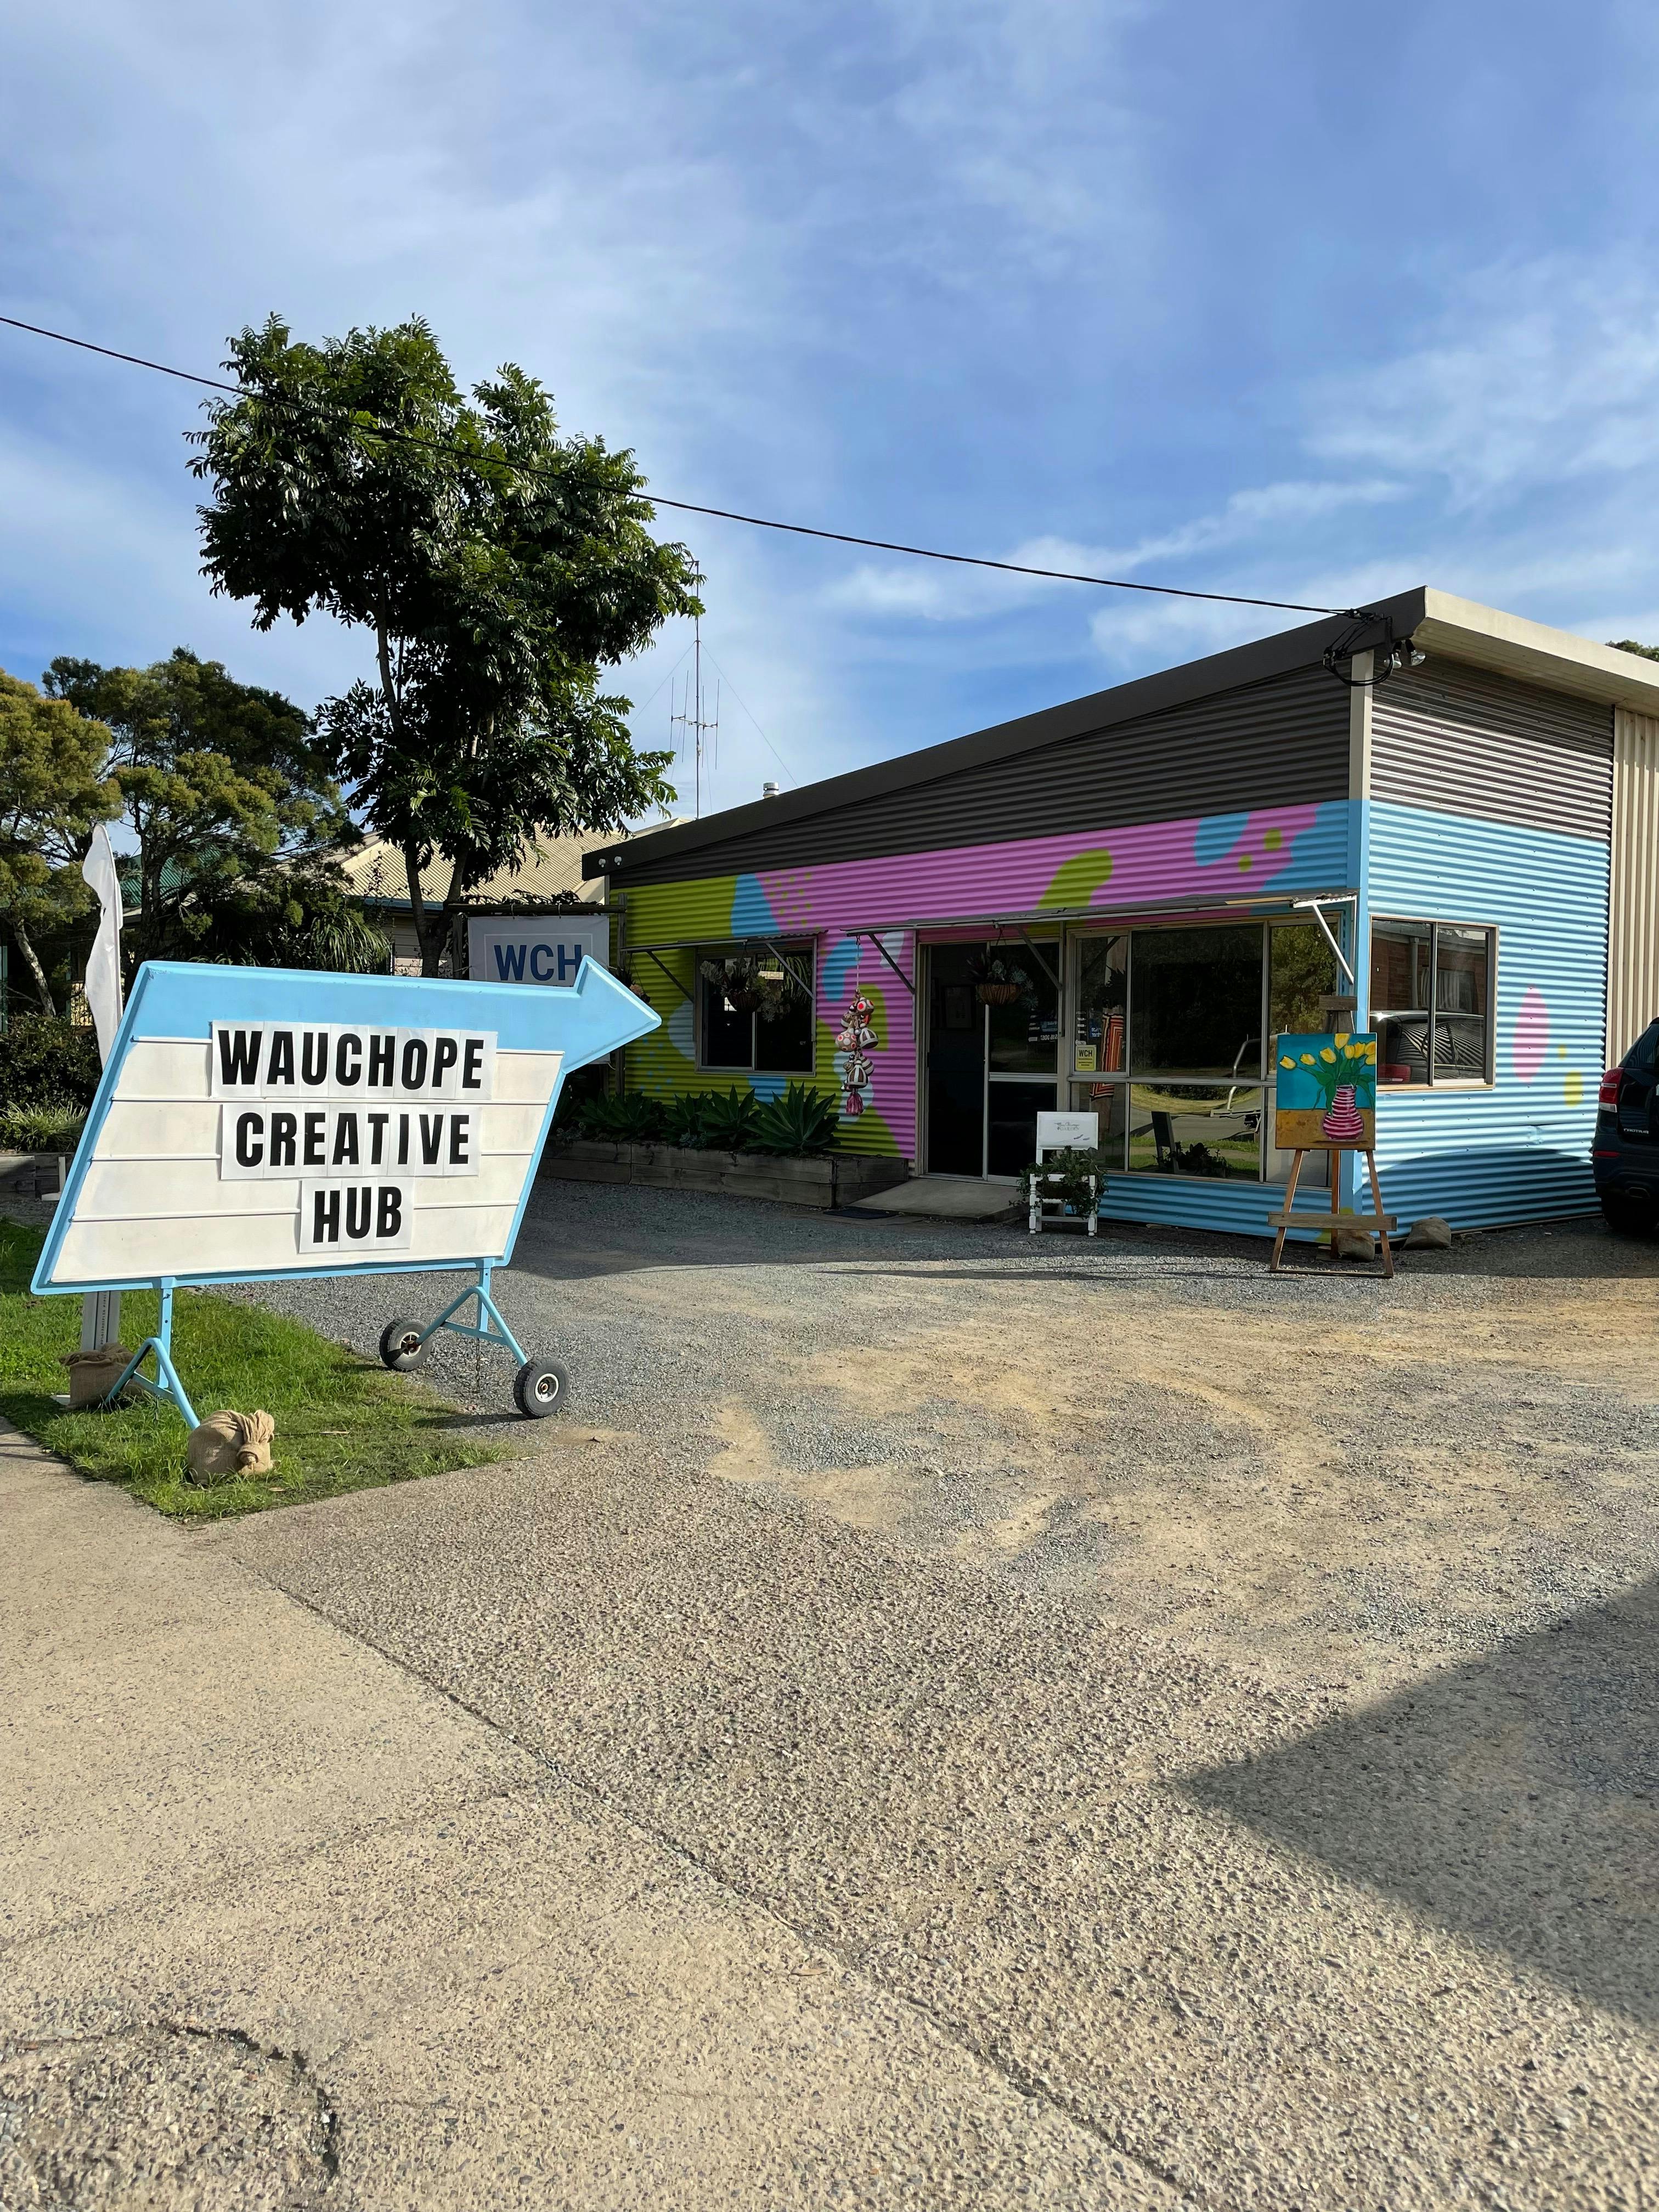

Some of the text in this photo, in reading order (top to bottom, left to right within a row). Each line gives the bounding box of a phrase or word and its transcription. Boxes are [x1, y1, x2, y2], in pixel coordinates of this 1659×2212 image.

[494, 944, 582, 981] WCH
[218, 1030, 484, 1090] WAUCHOPE
[236, 1112, 469, 1167] CREATIVE
[313, 1186, 402, 1243] HUB
